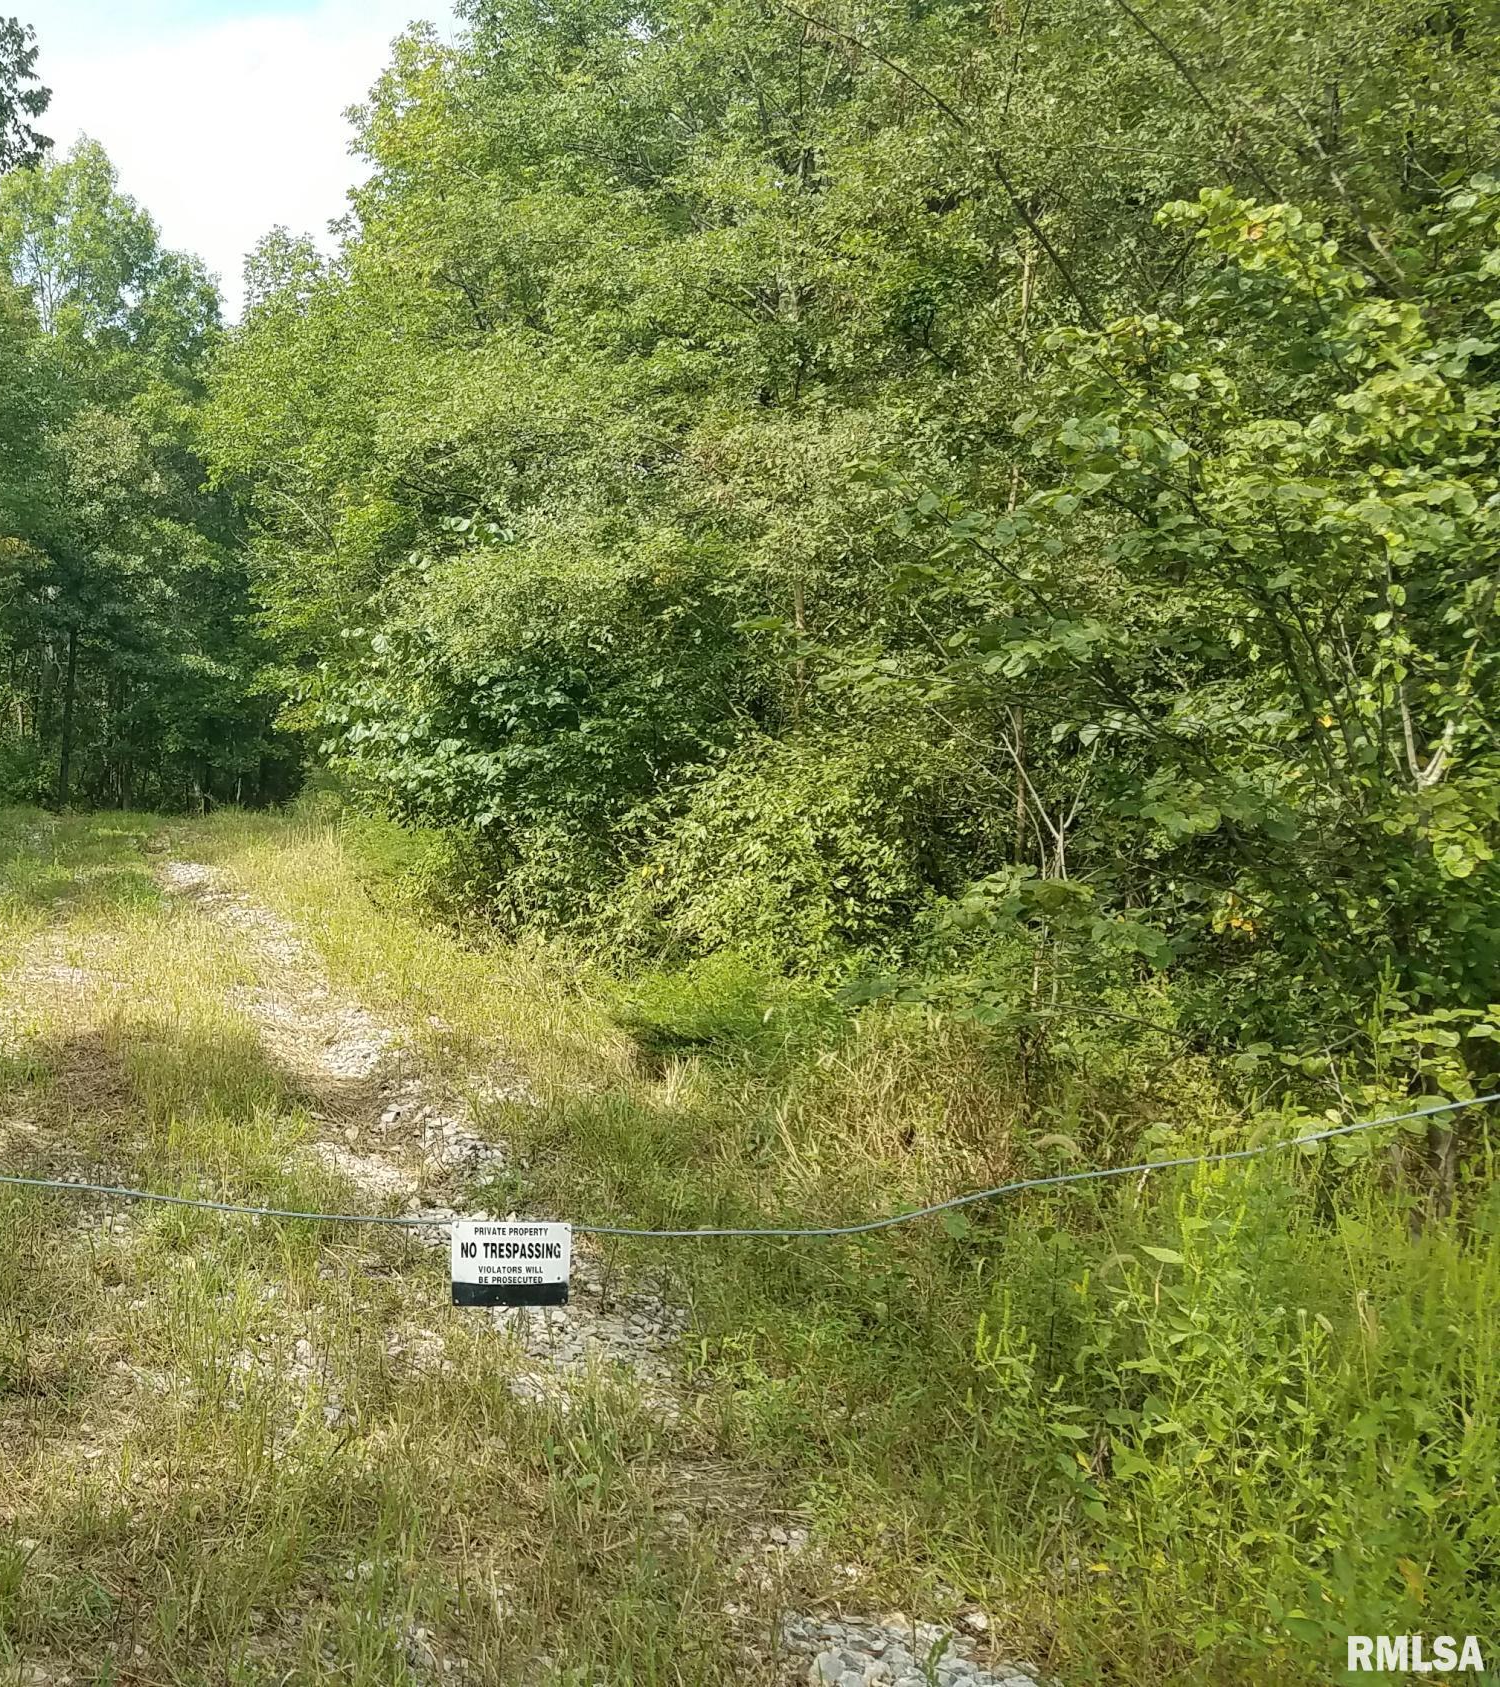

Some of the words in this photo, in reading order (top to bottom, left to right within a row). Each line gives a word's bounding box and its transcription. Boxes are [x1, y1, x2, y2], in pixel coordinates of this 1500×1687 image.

[474, 1227, 507, 1236] PRIVATE
[508, 1227, 549, 1236] PROPERTY
[460, 1242, 478, 1258] NO
[483, 1242, 562, 1259] TRESPASSING
[478, 1266, 523, 1274] VIOLATORS
[525, 1266, 544, 1274] WILL
[478, 1276, 489, 1284] BE
[491, 1276, 543, 1284] PROSECUTED
